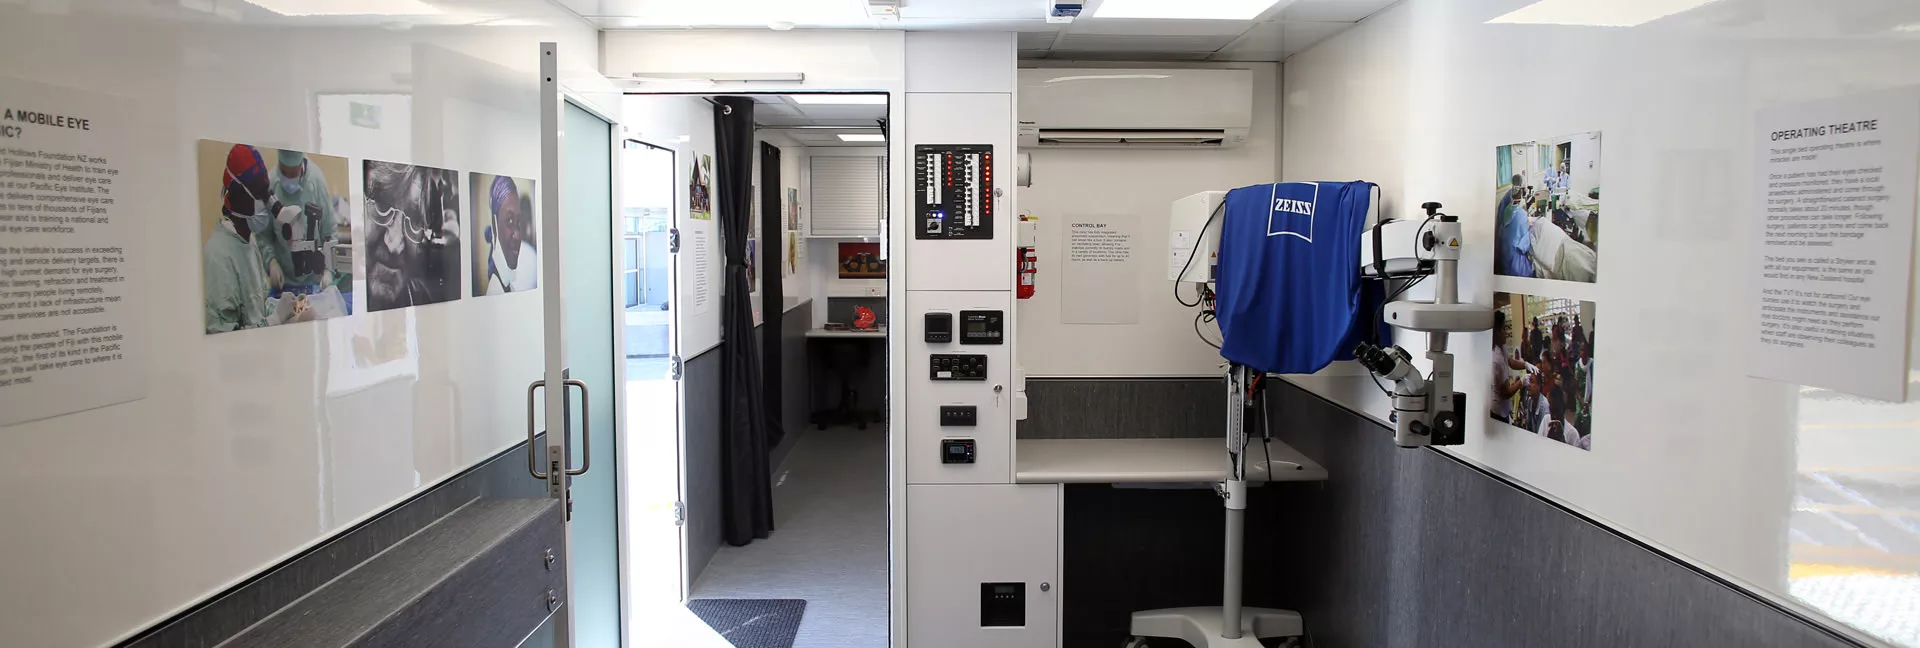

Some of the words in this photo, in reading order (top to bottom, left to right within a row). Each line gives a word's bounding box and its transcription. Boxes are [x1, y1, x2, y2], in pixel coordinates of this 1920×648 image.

[4, 108, 14, 120] A
[17, 110, 65, 127] MOBILE
[67, 117, 90, 130] EYE
[1771, 126, 1826, 141] OPERATING
[1828, 119, 1878, 134] THEATRE
[107, 168, 119, 176] eye
[55, 183, 68, 192] Eye
[97, 186, 110, 194] The
[88, 197, 99, 205] eye
[1275, 198, 1312, 215] ZEISS
[62, 328, 75, 336] The
[76, 325, 111, 335] Foundation
[103, 333, 123, 341] mobile
[101, 343, 121, 352] Pacific
